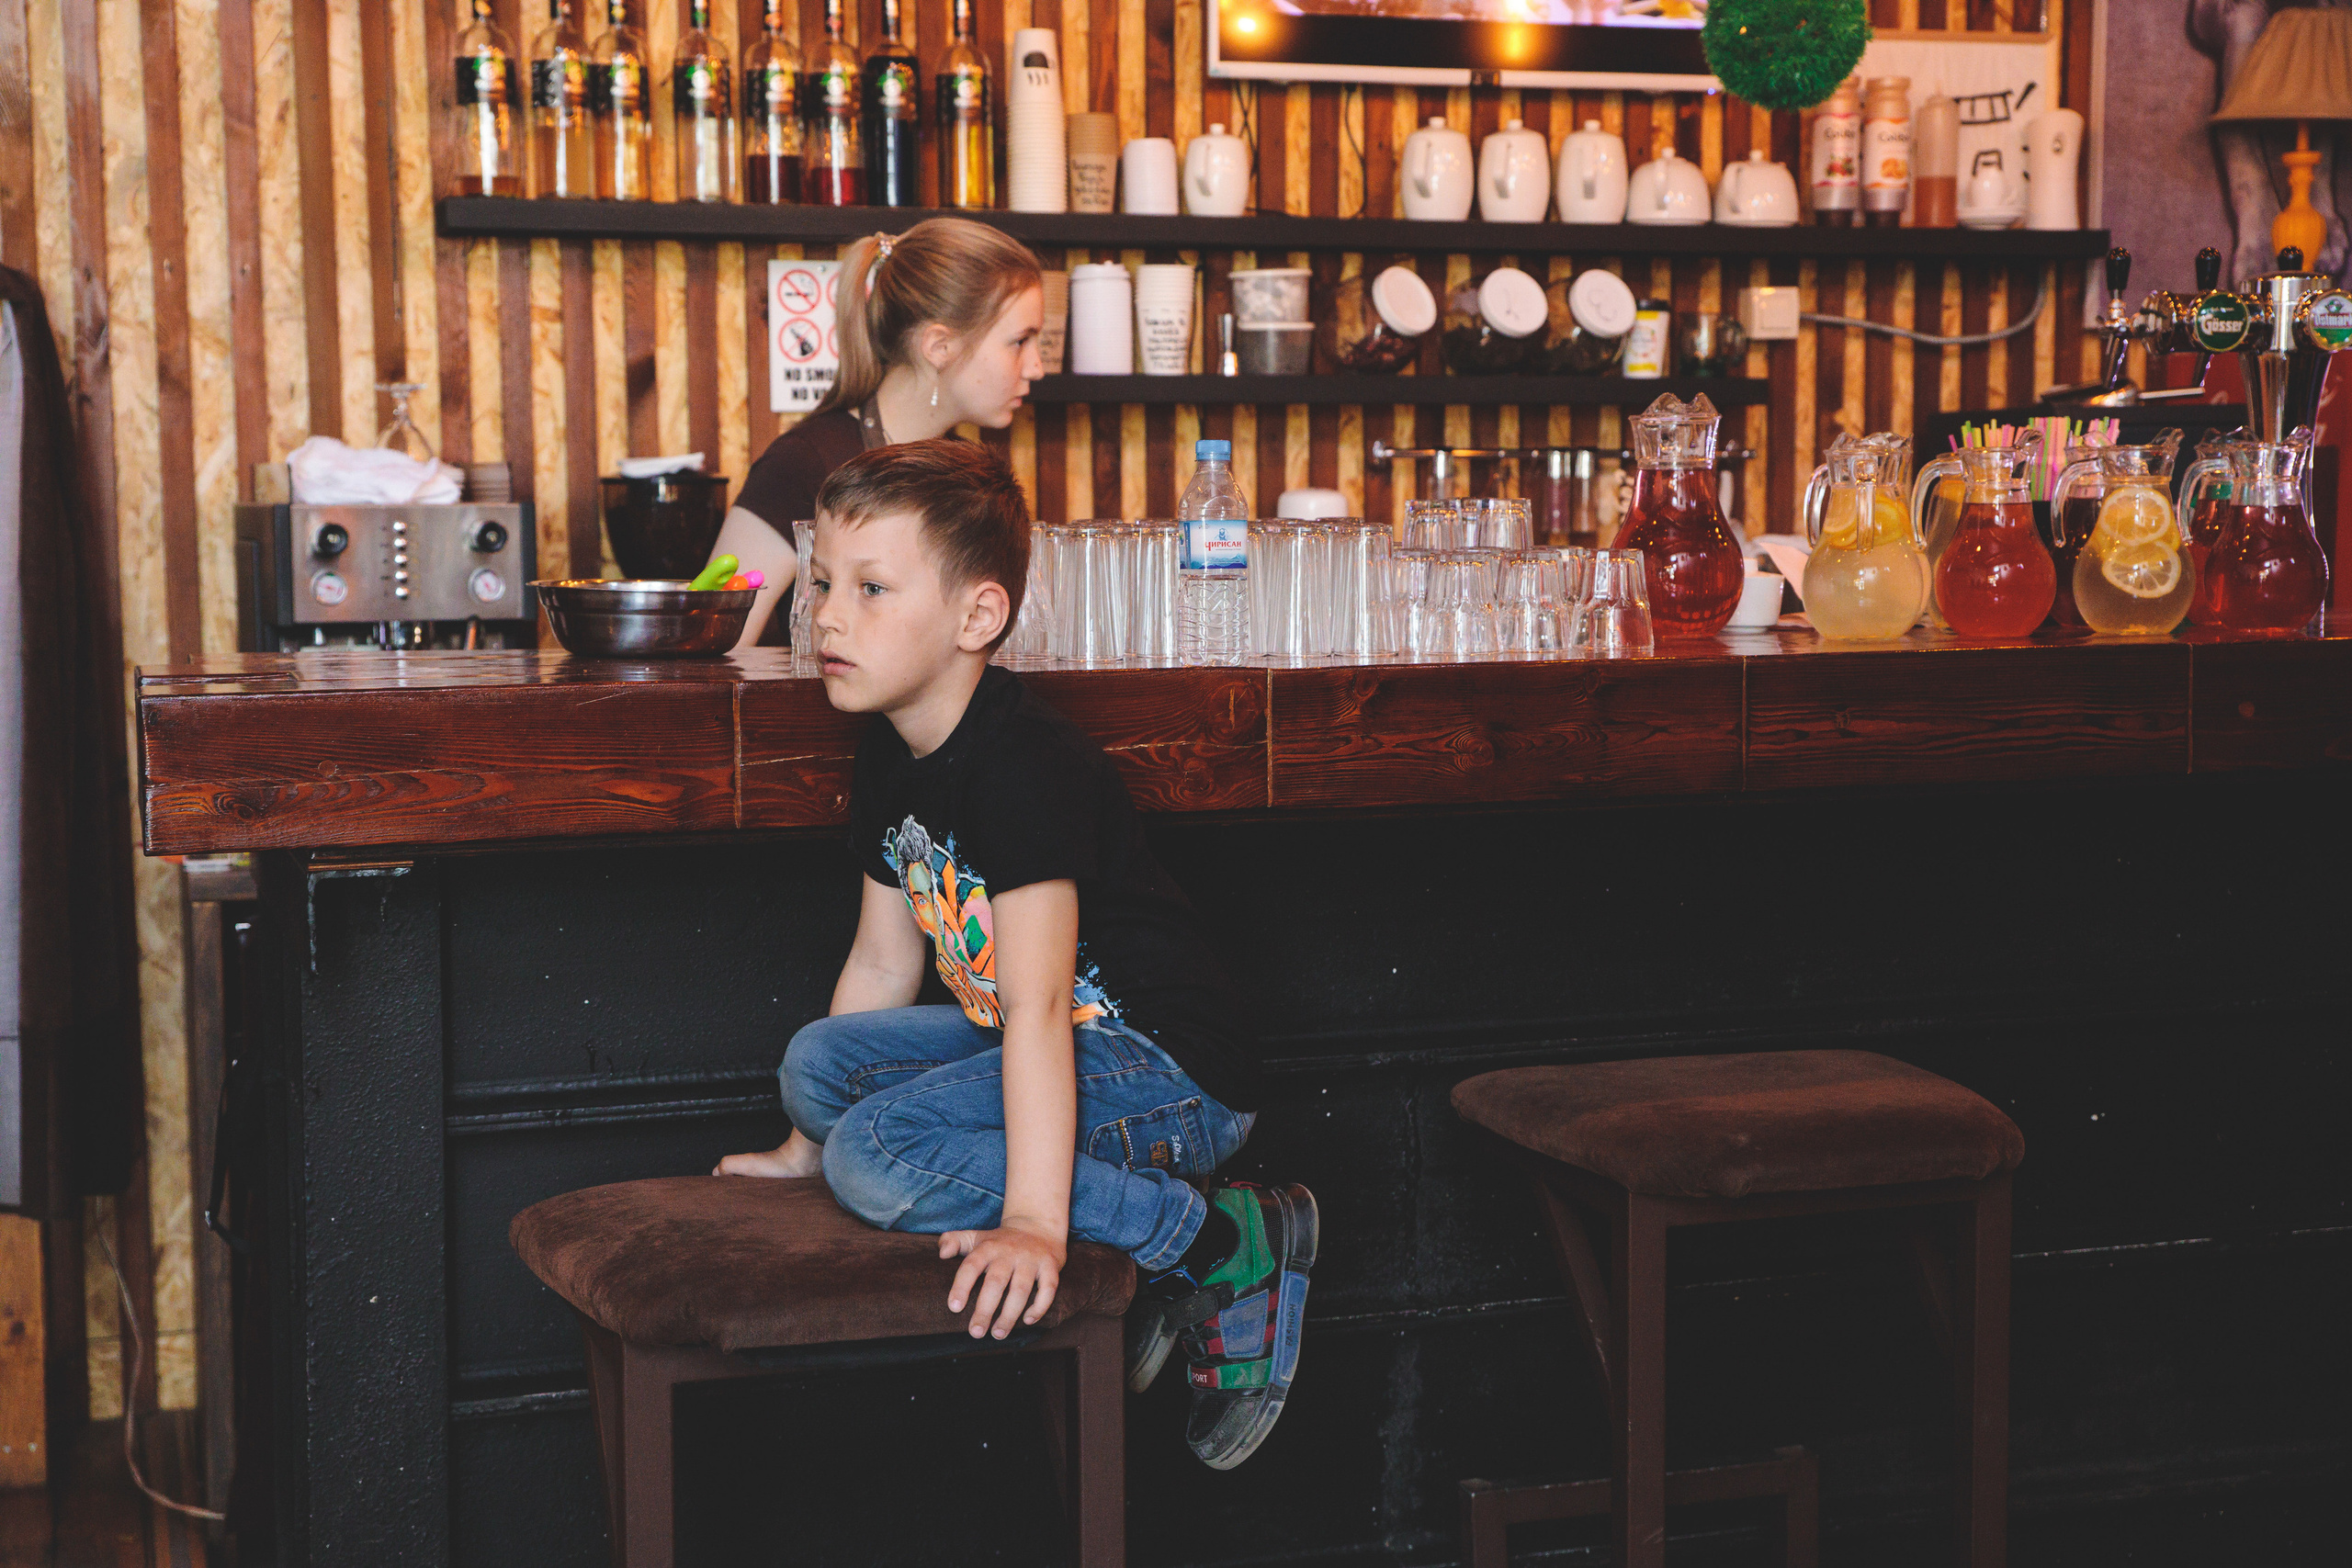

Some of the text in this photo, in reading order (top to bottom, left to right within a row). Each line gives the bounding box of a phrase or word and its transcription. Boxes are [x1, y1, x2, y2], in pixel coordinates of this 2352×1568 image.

[2199, 313, 2244, 336] Gösser
[785, 368, 801, 381] NO
[791, 387, 808, 400] NO
[1204, 541, 1242, 551] ЧИРИСАН
[1285, 1303, 1296, 1347] FASHION
